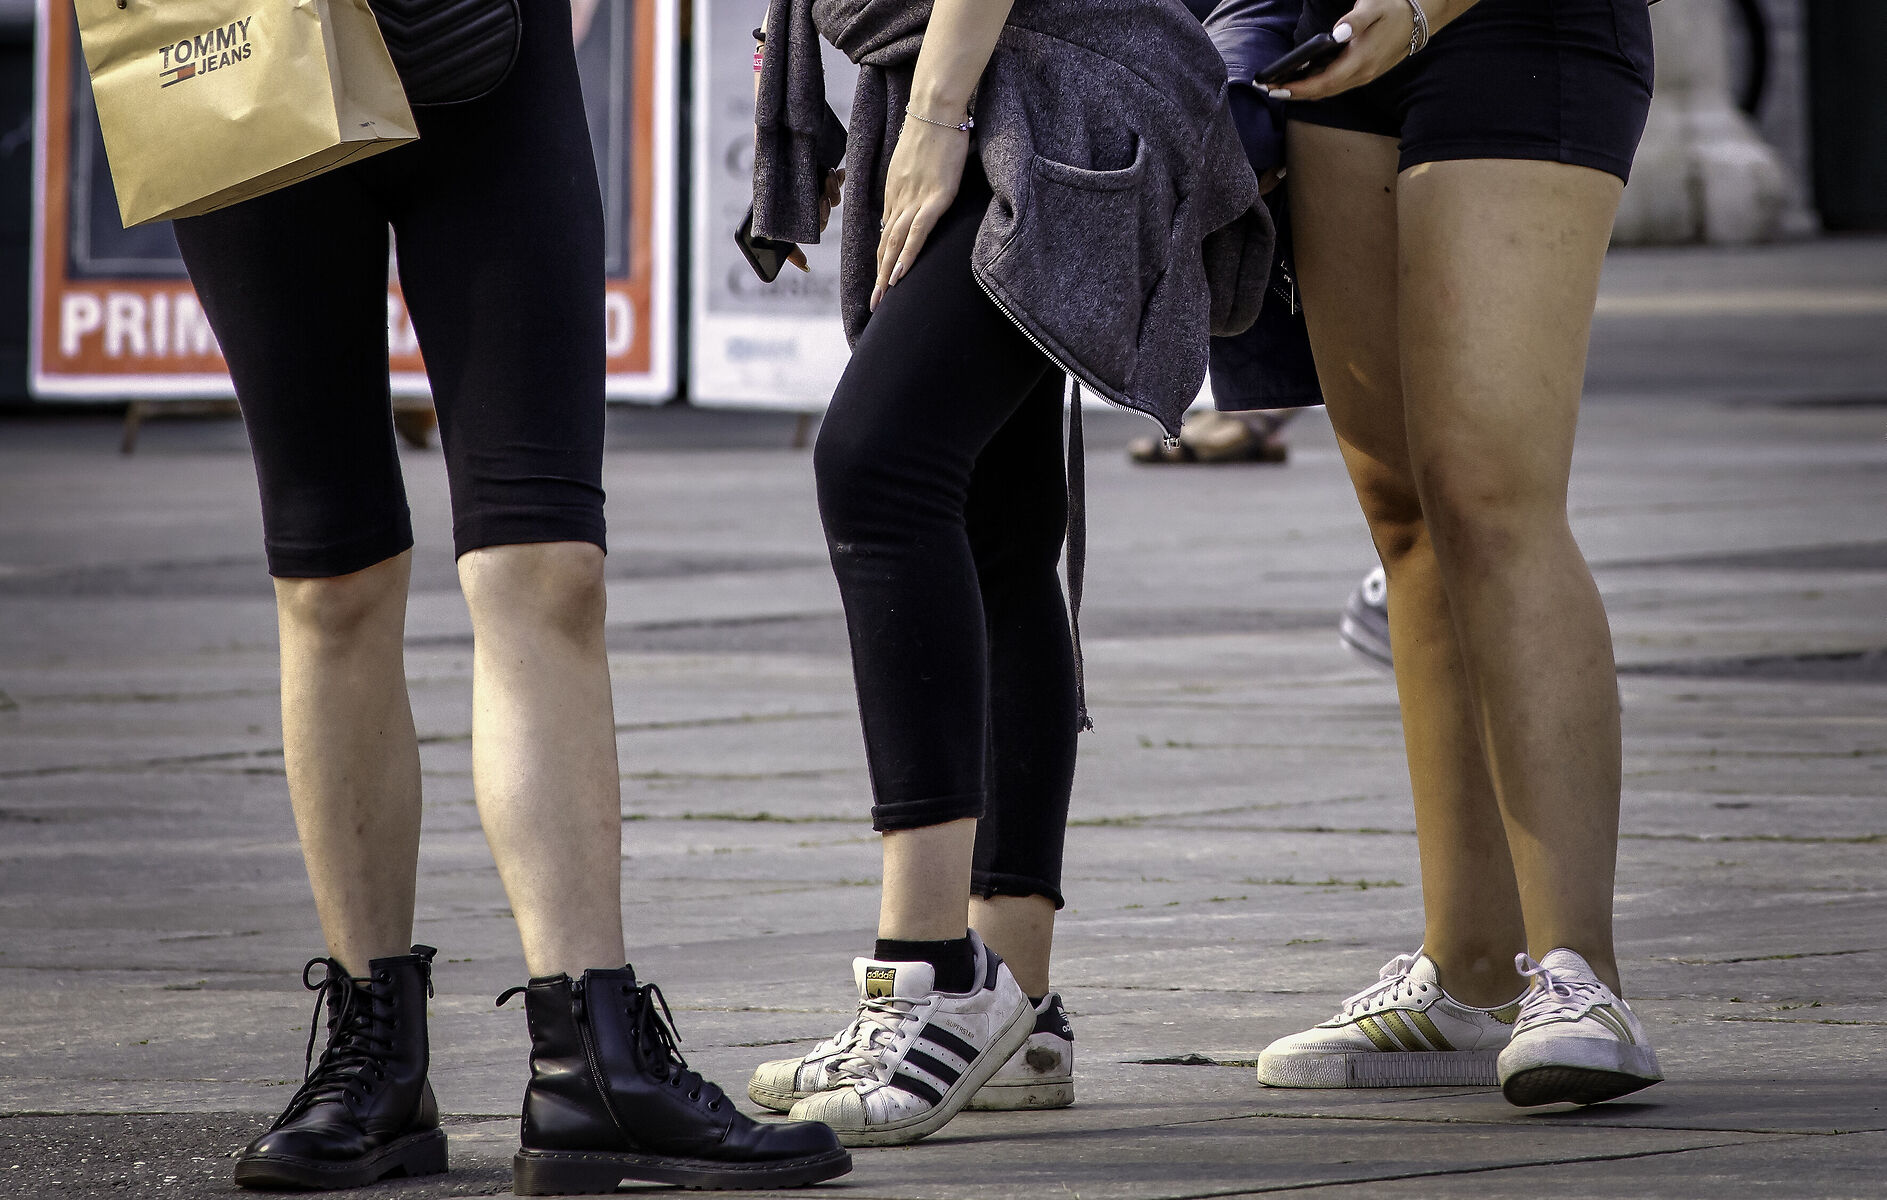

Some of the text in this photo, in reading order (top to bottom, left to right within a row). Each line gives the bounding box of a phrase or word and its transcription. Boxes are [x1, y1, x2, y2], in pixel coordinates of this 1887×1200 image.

[159, 16, 252, 69] TOMMY
[198, 43, 252, 75] JEANS
[866, 969, 894, 979] adidas
[945, 1019, 975, 1039] SUPERSTAR
